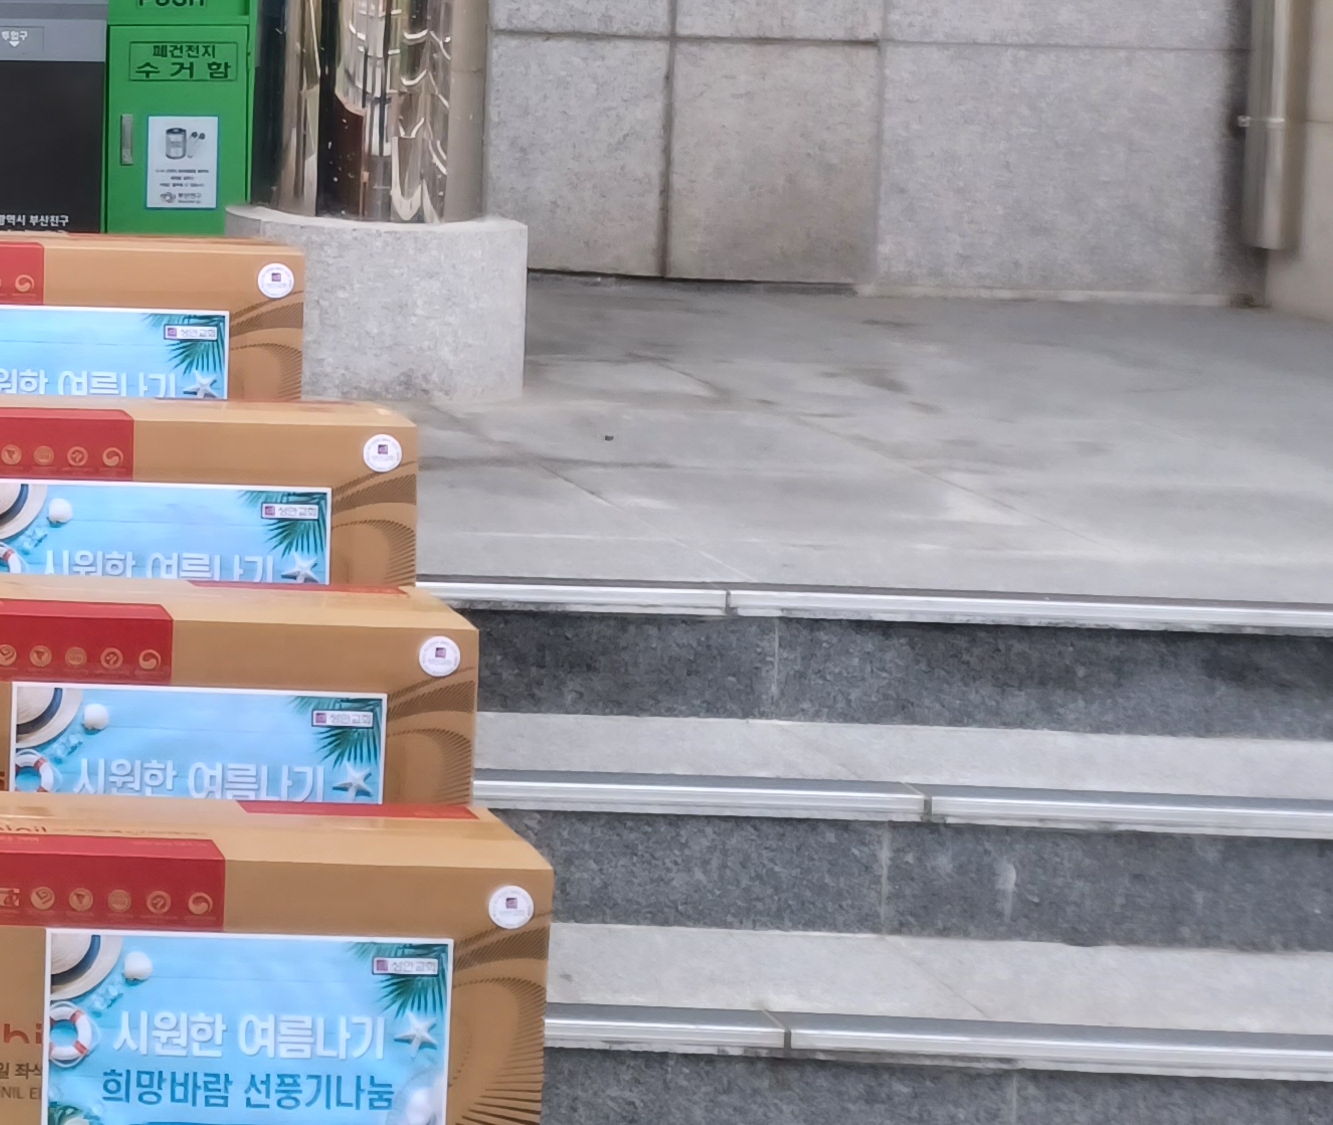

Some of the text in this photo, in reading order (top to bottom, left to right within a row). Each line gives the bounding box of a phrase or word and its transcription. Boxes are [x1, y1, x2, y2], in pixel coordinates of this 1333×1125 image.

[29, 215, 69, 227] 부산진구
[392, 958, 437, 973] 성안교회
[112, 1011, 385, 1060] 시원한 여름나기
[102, 1069, 395, 1110] 희망바람 선풍기나눔
